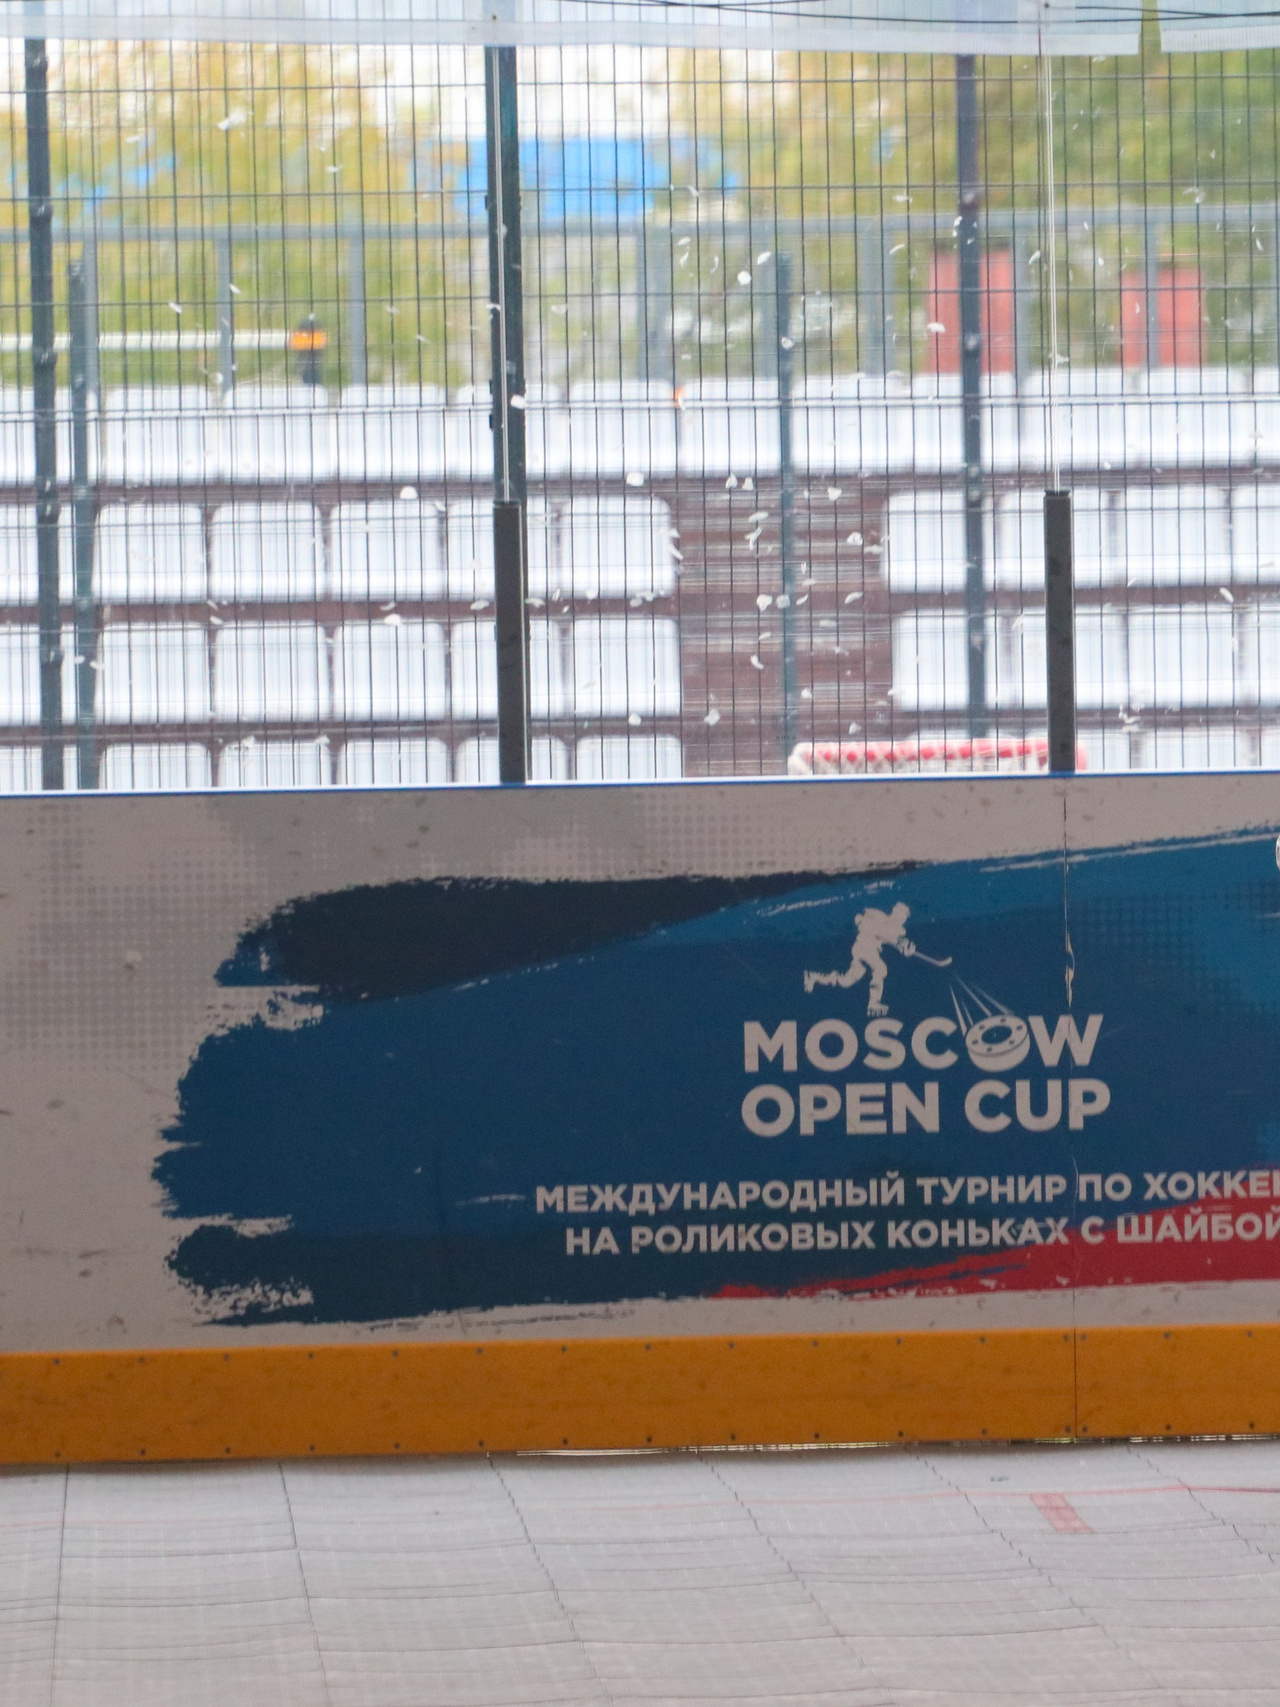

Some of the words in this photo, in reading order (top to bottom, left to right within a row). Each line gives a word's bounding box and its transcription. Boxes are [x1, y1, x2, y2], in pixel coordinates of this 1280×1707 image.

[743, 1014, 1104, 1073] MOSCOW
[741, 1081, 940, 1138] OPEN
[964, 1078, 1111, 1133] CUP
[535, 1170, 905, 1216] МЕЖДУНАРОДНЫЙ
[916, 1175, 1067, 1205] ТУРНИР
[1078, 1173, 1132, 1202] ПО
[565, 1227, 620, 1255] НА
[631, 1220, 876, 1254] РОЛИКОВЫХ
[887, 1216, 1070, 1249] КОНЬКАХ
[1080, 1216, 1105, 1244] С
